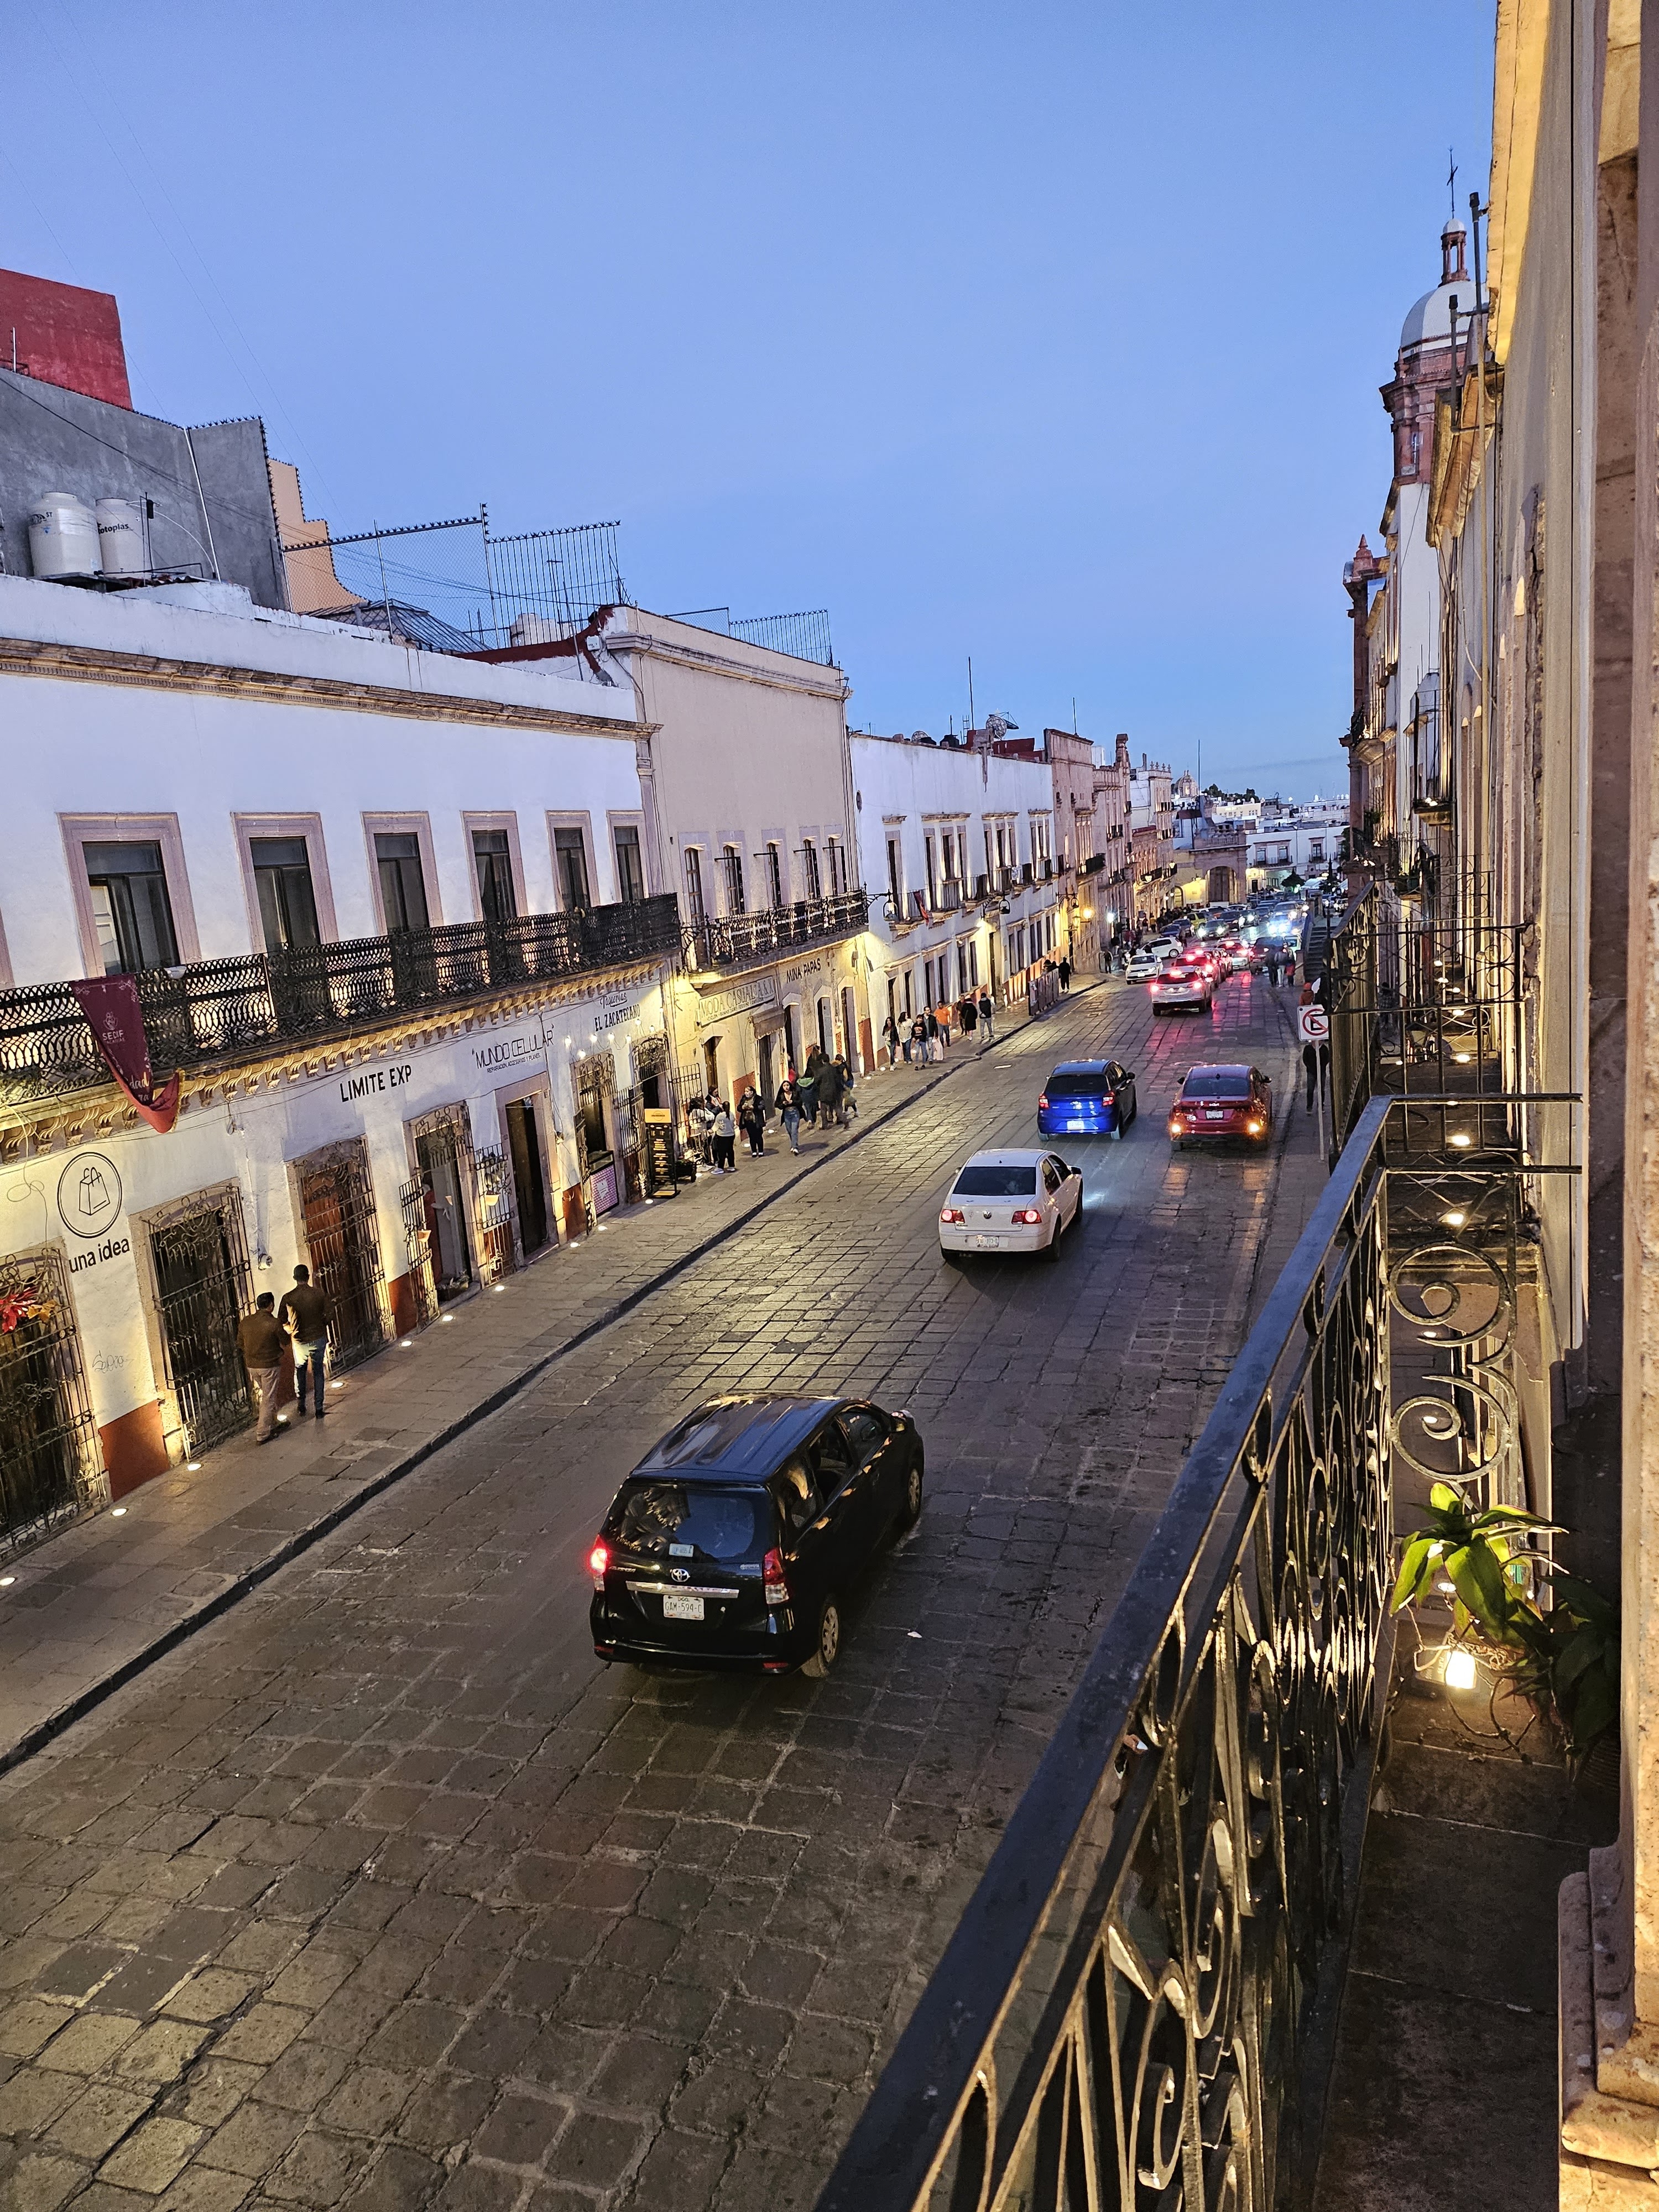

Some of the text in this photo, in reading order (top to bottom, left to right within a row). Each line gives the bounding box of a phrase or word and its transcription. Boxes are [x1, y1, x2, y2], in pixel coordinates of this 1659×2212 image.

[786, 958, 821, 984] MINA PAPAS
[594, 1004, 640, 1032] EL ZACATECANO
[701, 997, 726, 1018] MODA
[102, 1030, 124, 1040] SEDIF
[340, 1065, 412, 1103] LIMITE EXP
[69, 1238, 130, 1273] una idea
[665, 1601, 702, 1613] GAM-594-C
